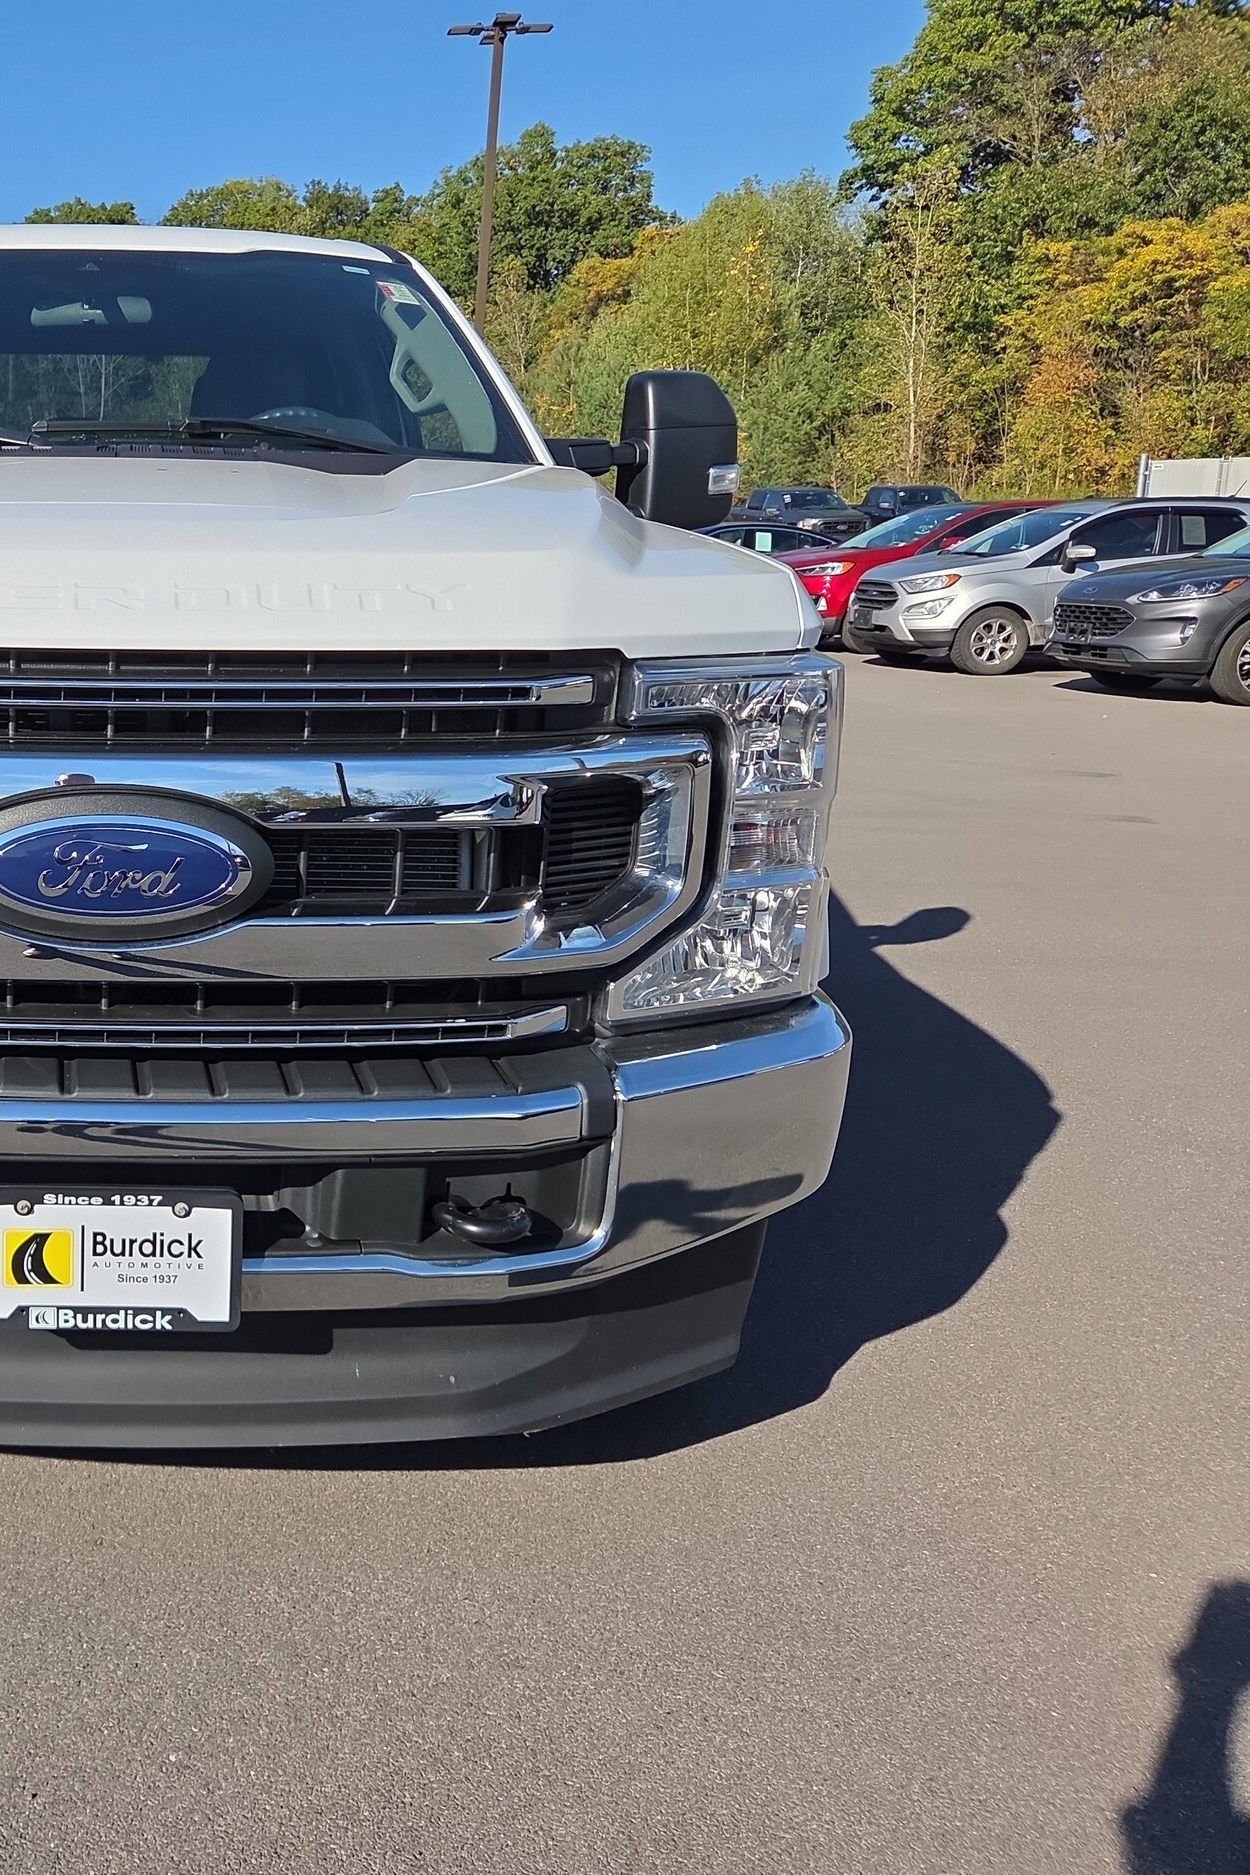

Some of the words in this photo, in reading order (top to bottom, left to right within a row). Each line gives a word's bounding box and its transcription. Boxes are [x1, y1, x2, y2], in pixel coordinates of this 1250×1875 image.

[173, 581, 472, 613] DUTY
[36, 838, 186, 899] Ford
[43, 1194, 103, 1206] Since
[110, 1194, 163, 1207] 1937
[91, 1231, 205, 1260] Burdick
[91, 1261, 205, 1271] AUTOMOTIVE
[116, 1273, 149, 1285] Since
[151, 1274, 179, 1285] 1937
[57, 1308, 174, 1331] Burdick
